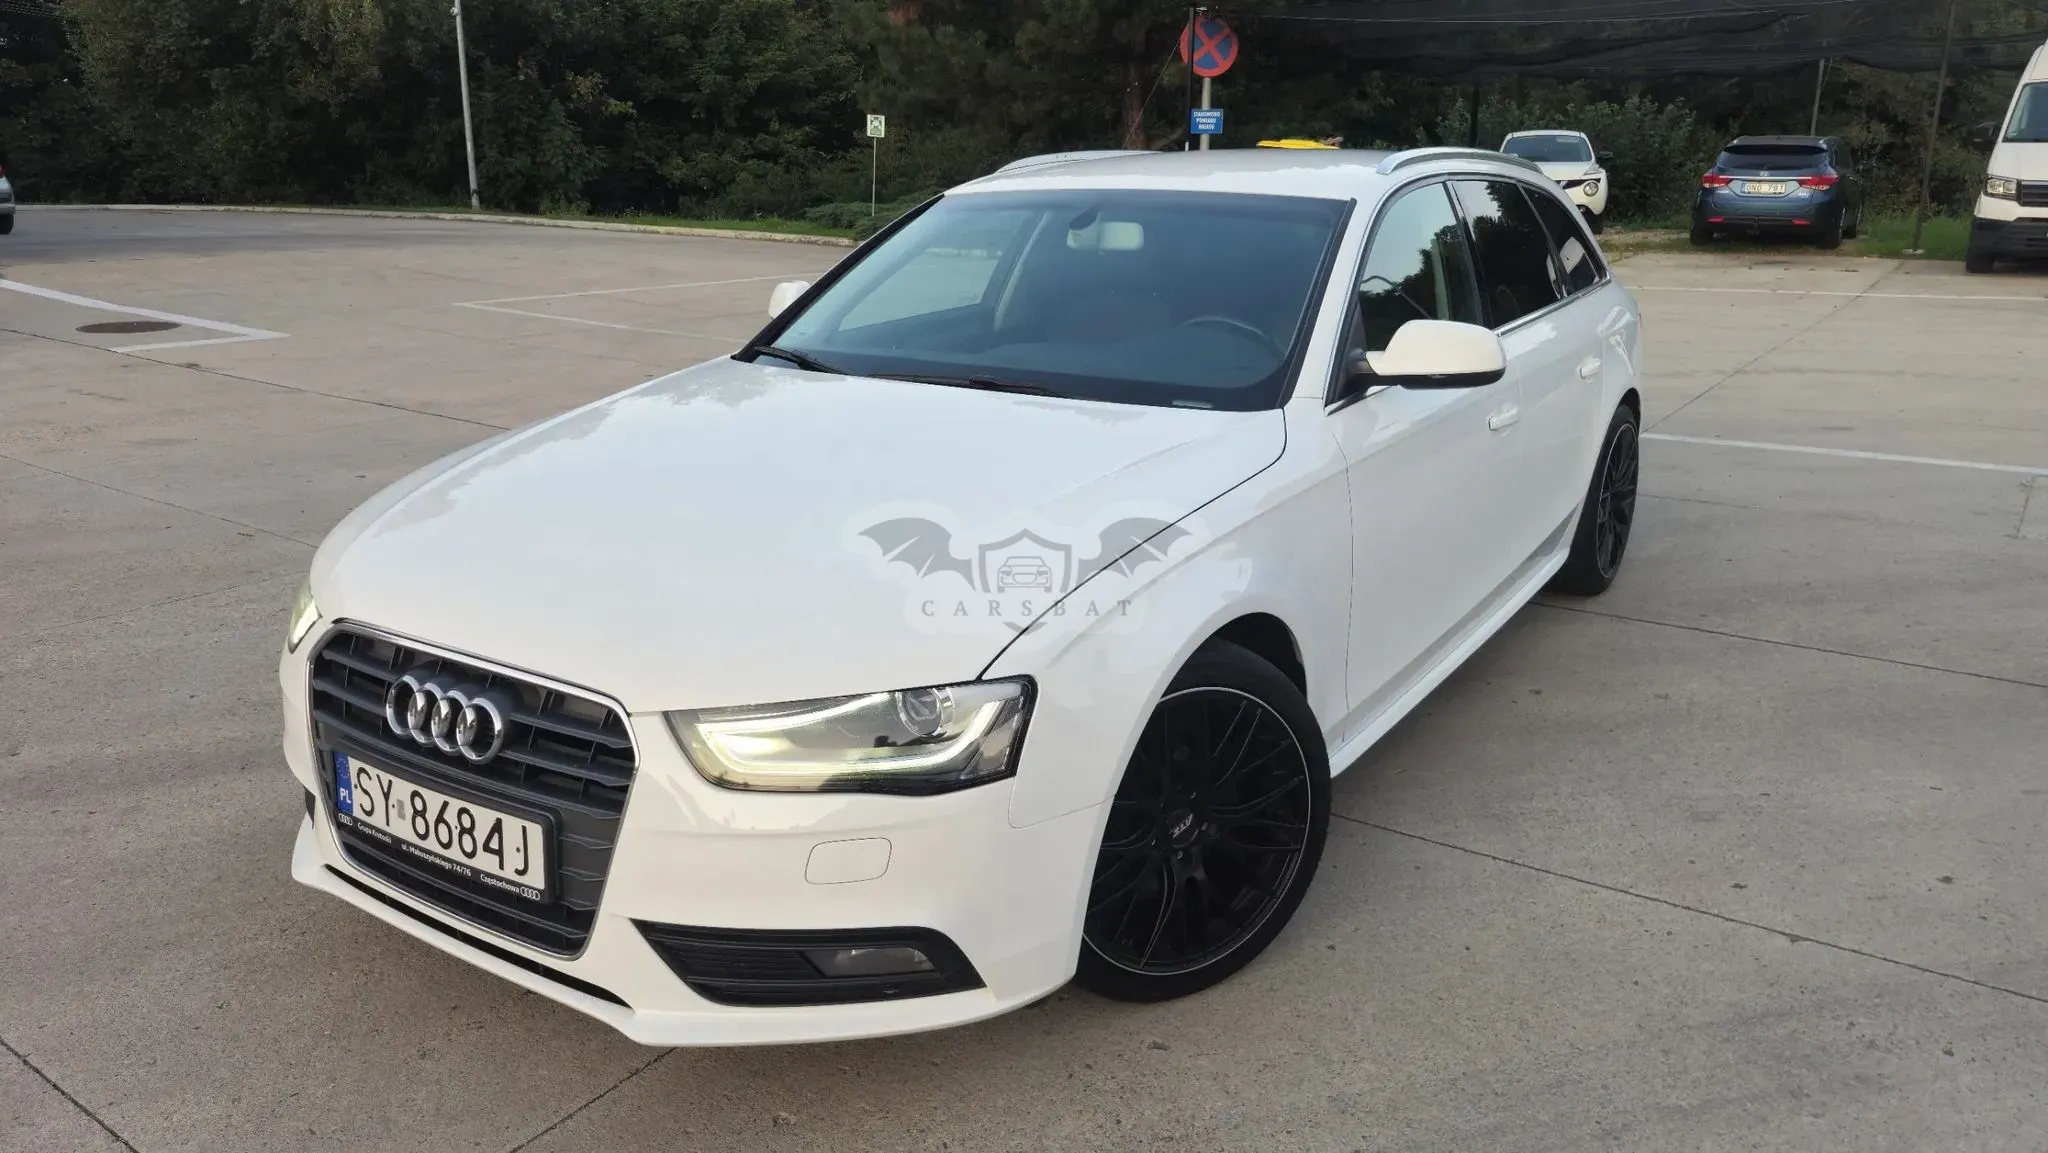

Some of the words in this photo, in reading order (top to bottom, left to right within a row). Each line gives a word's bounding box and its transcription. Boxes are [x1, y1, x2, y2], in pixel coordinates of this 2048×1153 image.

[339, 787, 352, 804] PL
[356, 766, 393, 827] SY
[409, 789, 530, 877] 8684J
[480, 873, 520, 894] Częstochowa
